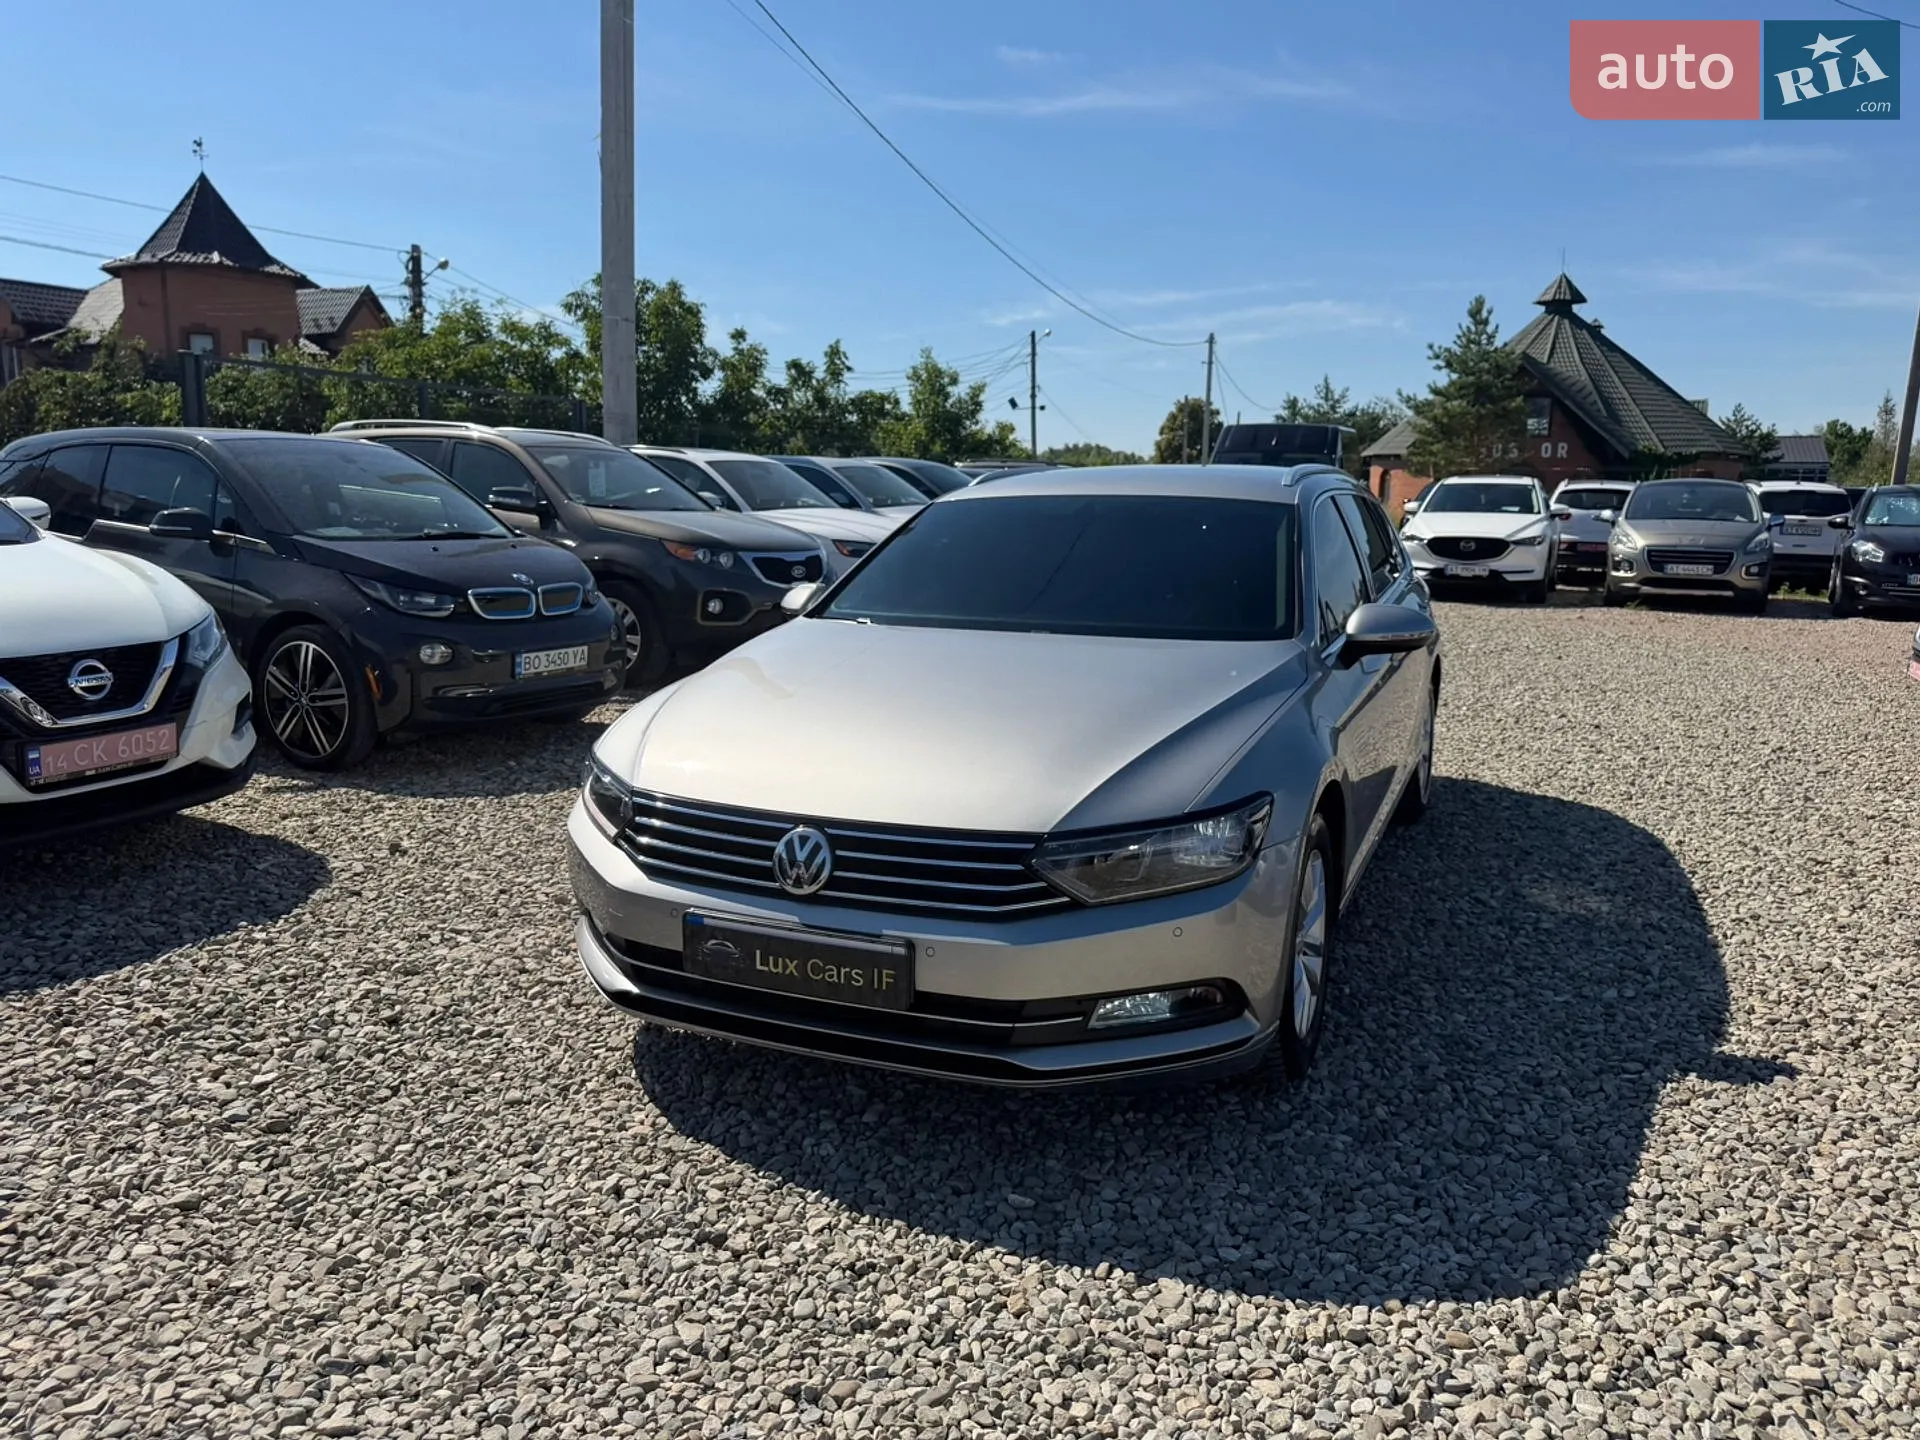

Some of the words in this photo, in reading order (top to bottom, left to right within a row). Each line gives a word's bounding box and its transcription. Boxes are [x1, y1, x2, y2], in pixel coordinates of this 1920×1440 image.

[523, 655, 541, 672] BO
[543, 651, 570, 669] 3450
[572, 647, 586, 664] YA
[45, 753, 67, 773] 14
[74, 738, 108, 766] CK
[117, 728, 169, 759] 6052
[28, 766, 41, 776] UA
[755, 949, 798, 977] Lux
[806, 957, 864, 987] Cars
[873, 968, 896, 991] IF
